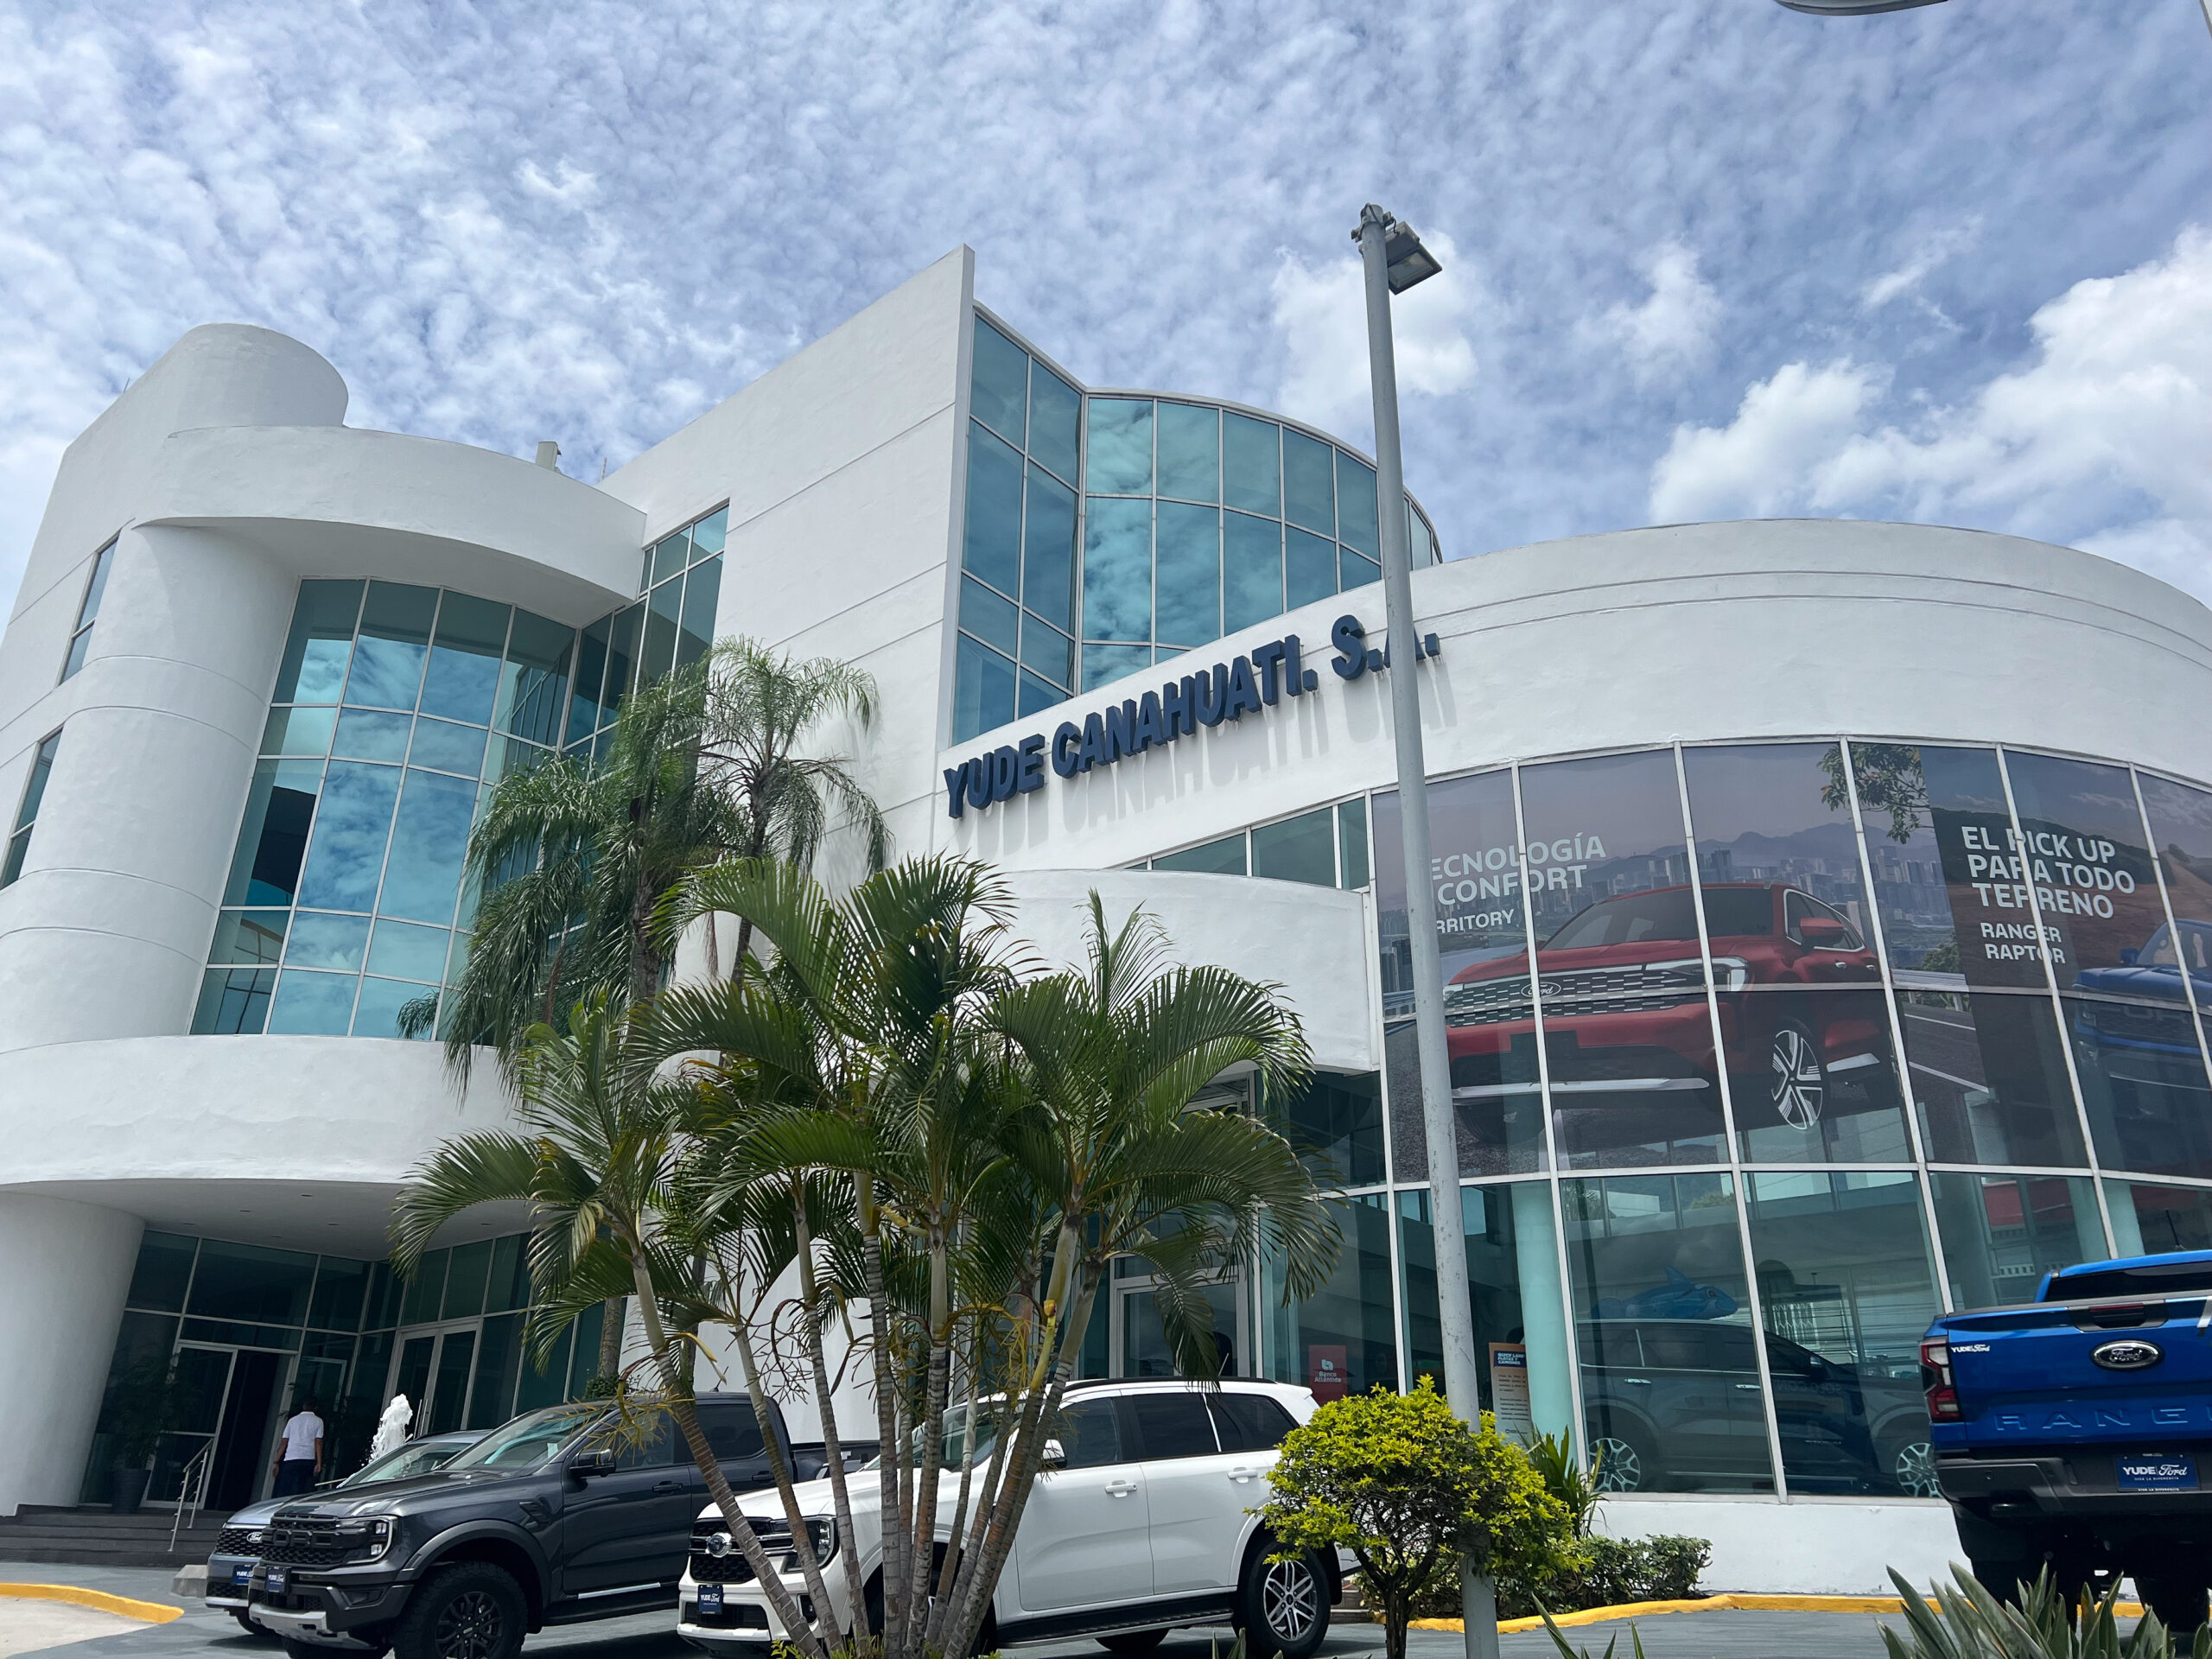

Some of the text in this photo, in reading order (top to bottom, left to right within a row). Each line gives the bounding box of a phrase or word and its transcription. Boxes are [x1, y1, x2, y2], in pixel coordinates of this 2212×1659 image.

[943, 614, 1440, 819] YUDE CANAHUATI. S..
[1431, 832, 1606, 880] ECNOLOGÍA
[1961, 826, 2116, 864] EL PICK UP
[1437, 864, 1587, 906] CONFORT
[2055, 861, 2136, 894] TODO
[1971, 882, 2115, 919] TERRENO
[1436, 909, 1515, 934] RRITORY
[1980, 922, 2063, 943] RANGER
[2109, 1348, 2143, 1363] Ford
[1993, 1408, 2212, 1431] RANG
[2122, 1464, 2188, 1476] YUDE Ford
